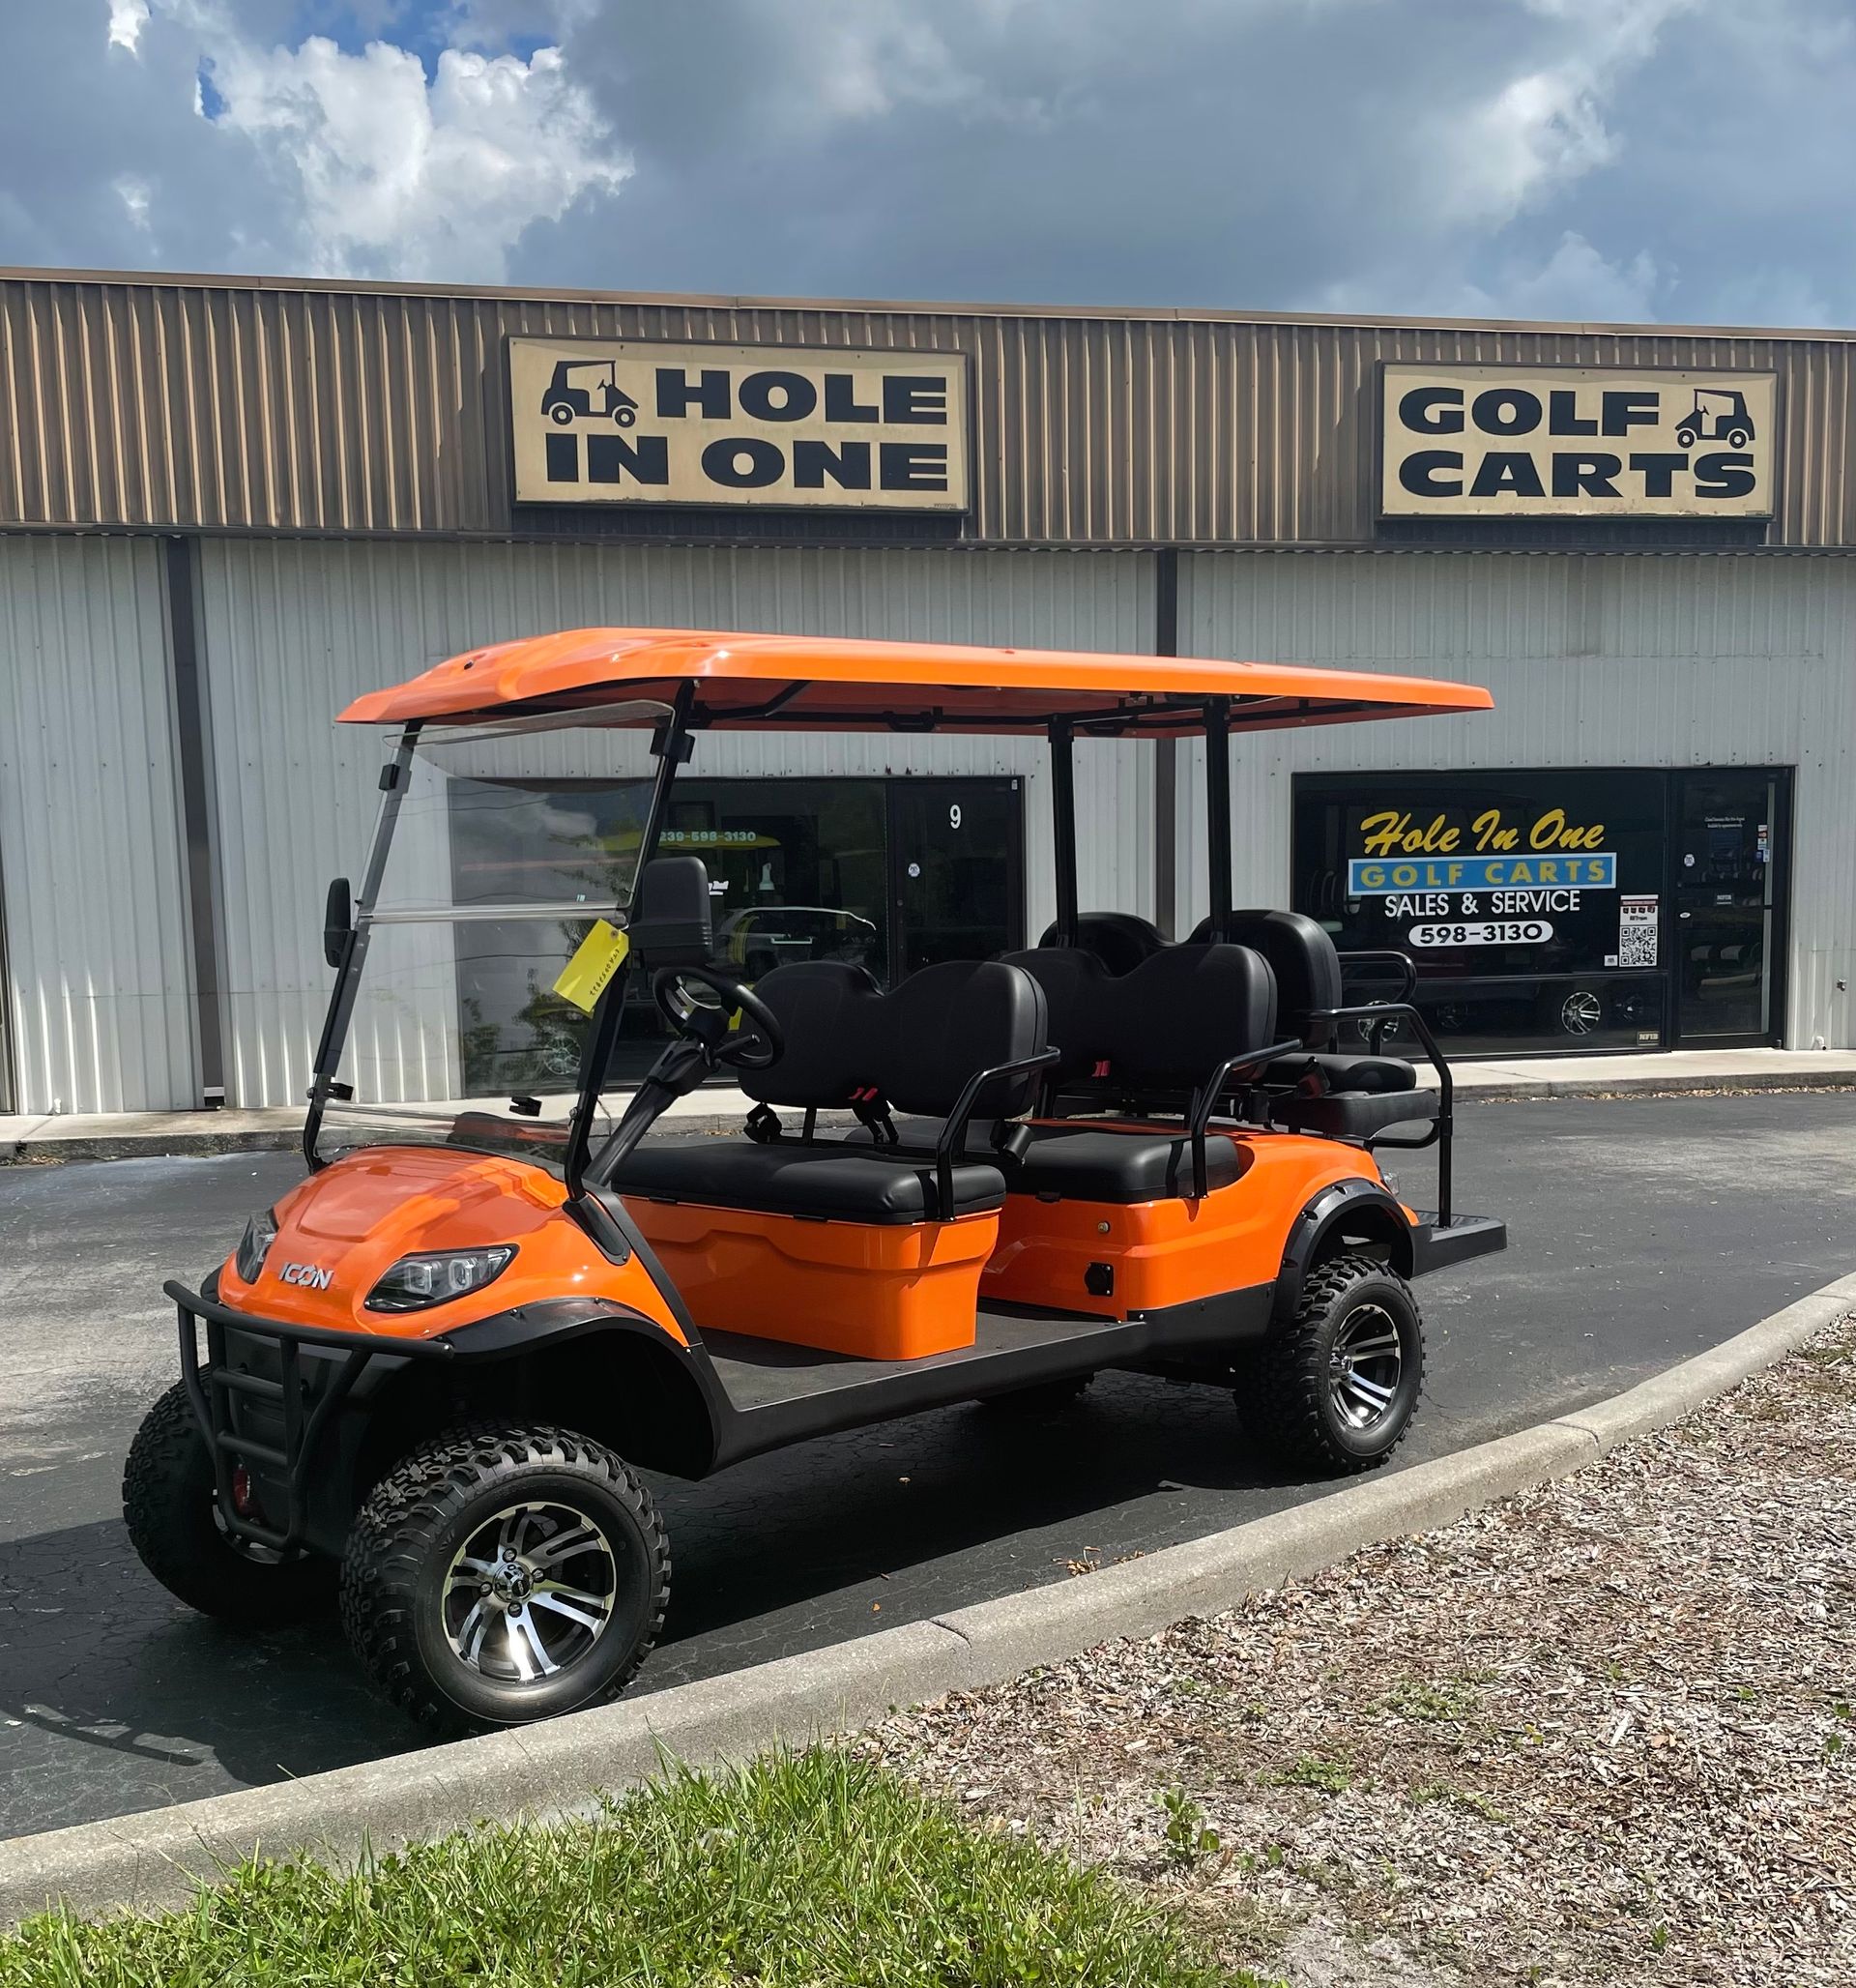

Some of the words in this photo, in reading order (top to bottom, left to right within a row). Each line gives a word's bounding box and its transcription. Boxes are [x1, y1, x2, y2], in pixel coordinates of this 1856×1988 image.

[655, 367, 947, 425] HOLE
[1399, 387, 1660, 437] GOLF
[545, 432, 669, 485] IN
[701, 437, 948, 491] ONE
[1399, 450, 1756, 498] CARTS
[949, 804, 962, 830] 9
[1360, 811, 1460, 857] Hole
[1471, 809, 1519, 852] In
[1529, 808, 1605, 851] One
[1360, 864, 1464, 888] GOLF
[1485, 861, 1606, 885] CARTS
[1384, 893, 1449, 918] SALES
[1461, 892, 1479, 915] &
[1491, 891, 1580, 914] SERVICE
[1419, 924, 1543, 944] 598-3130
[277, 1261, 334, 1291] ICON
